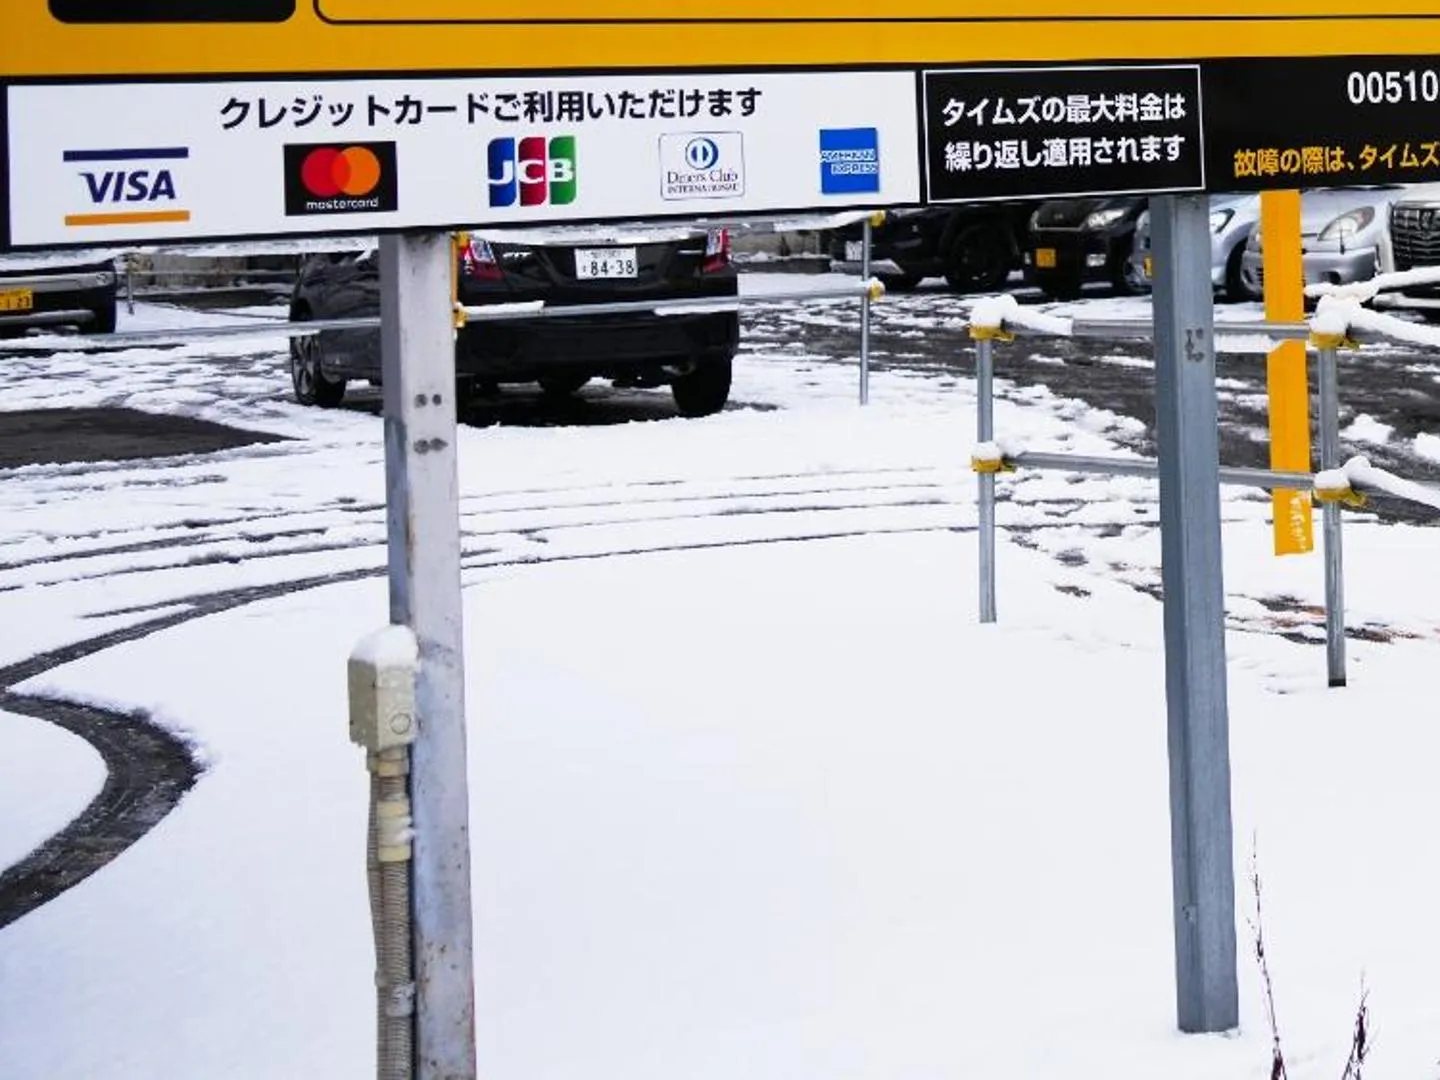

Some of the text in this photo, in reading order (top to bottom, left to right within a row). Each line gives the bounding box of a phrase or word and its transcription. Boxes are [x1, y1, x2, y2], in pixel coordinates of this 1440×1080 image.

[219, 87, 764, 130] クレジットカードご利用いただけます
[942, 91, 1187, 127] タイムズの最大料金は
[820, 149, 876, 163] AMERICAN
[944, 134, 1186, 172] 繰り返し適用されます
[666, 168, 739, 185] Diners Club
[831, 163, 880, 175] EXPRESS
[78, 170, 177, 204] VISA
[305, 196, 380, 211] mastercard
